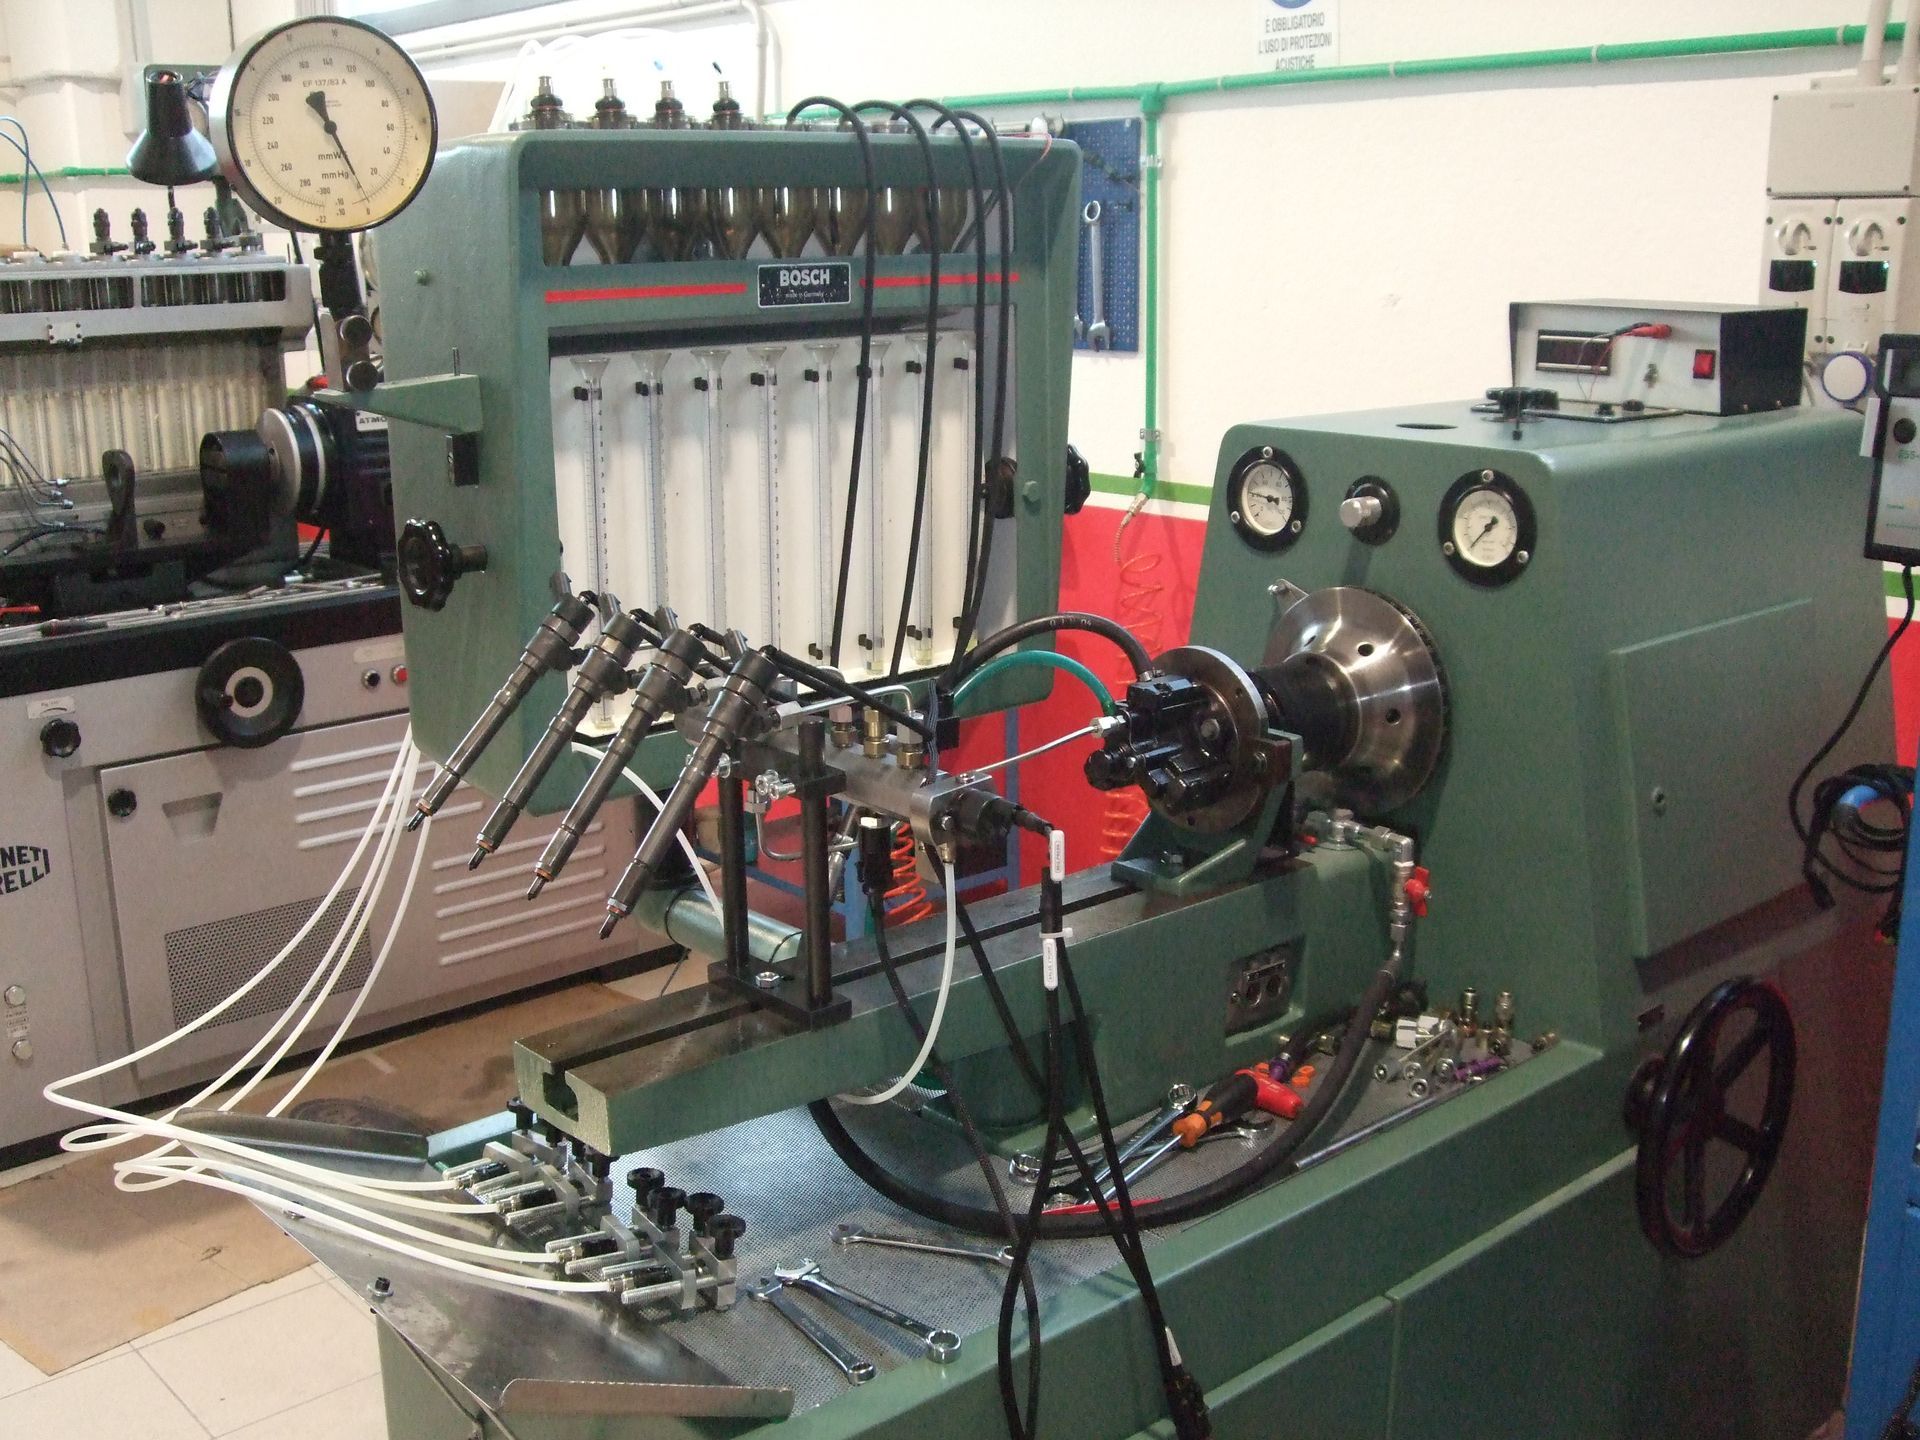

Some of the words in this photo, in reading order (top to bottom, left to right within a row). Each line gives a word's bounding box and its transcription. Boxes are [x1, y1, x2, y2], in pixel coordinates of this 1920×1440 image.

[1272, 12, 1325, 32] OBBLIGATORIO
[1281, 37, 1288, 52] DI
[1290, 32, 1332, 50] PROTEZIONI
[1275, 54, 1315, 71] ACUSTICHE
[268, 93, 279, 102] 200
[381, 99, 389, 108] 80
[262, 116, 273, 124] 220
[386, 123, 394, 131] 60
[267, 141, 278, 150] 240
[383, 147, 390, 155] 40
[281, 163, 292, 172] 260
[370, 167, 377, 175] 20
[321, 171, 349, 179] mmHg
[780, 269, 830, 286] BOSCH
